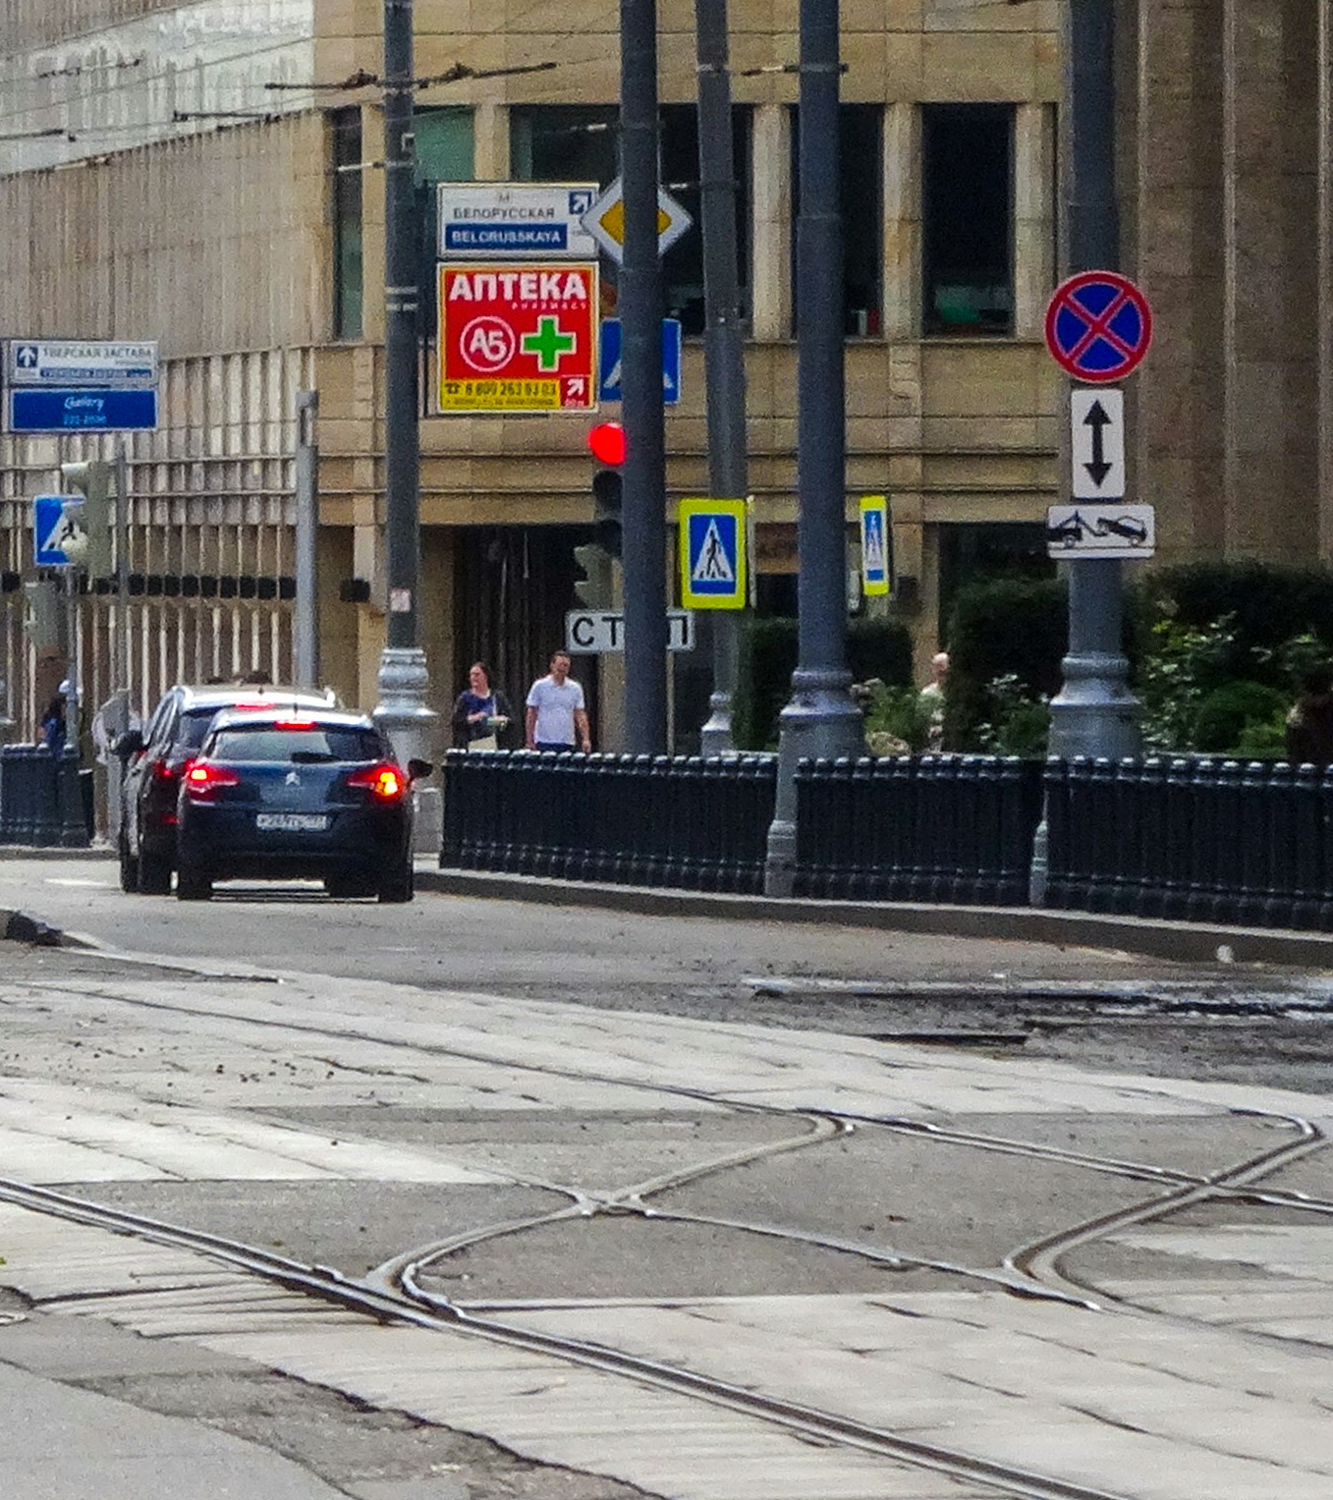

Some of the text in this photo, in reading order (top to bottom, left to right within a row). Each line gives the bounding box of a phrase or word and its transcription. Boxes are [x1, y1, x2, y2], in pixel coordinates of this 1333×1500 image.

[453, 207, 555, 220] БЕЛОРУССКАЯ
[448, 272, 587, 302] АПТЕКА
[572, 616, 688, 647] СТП
